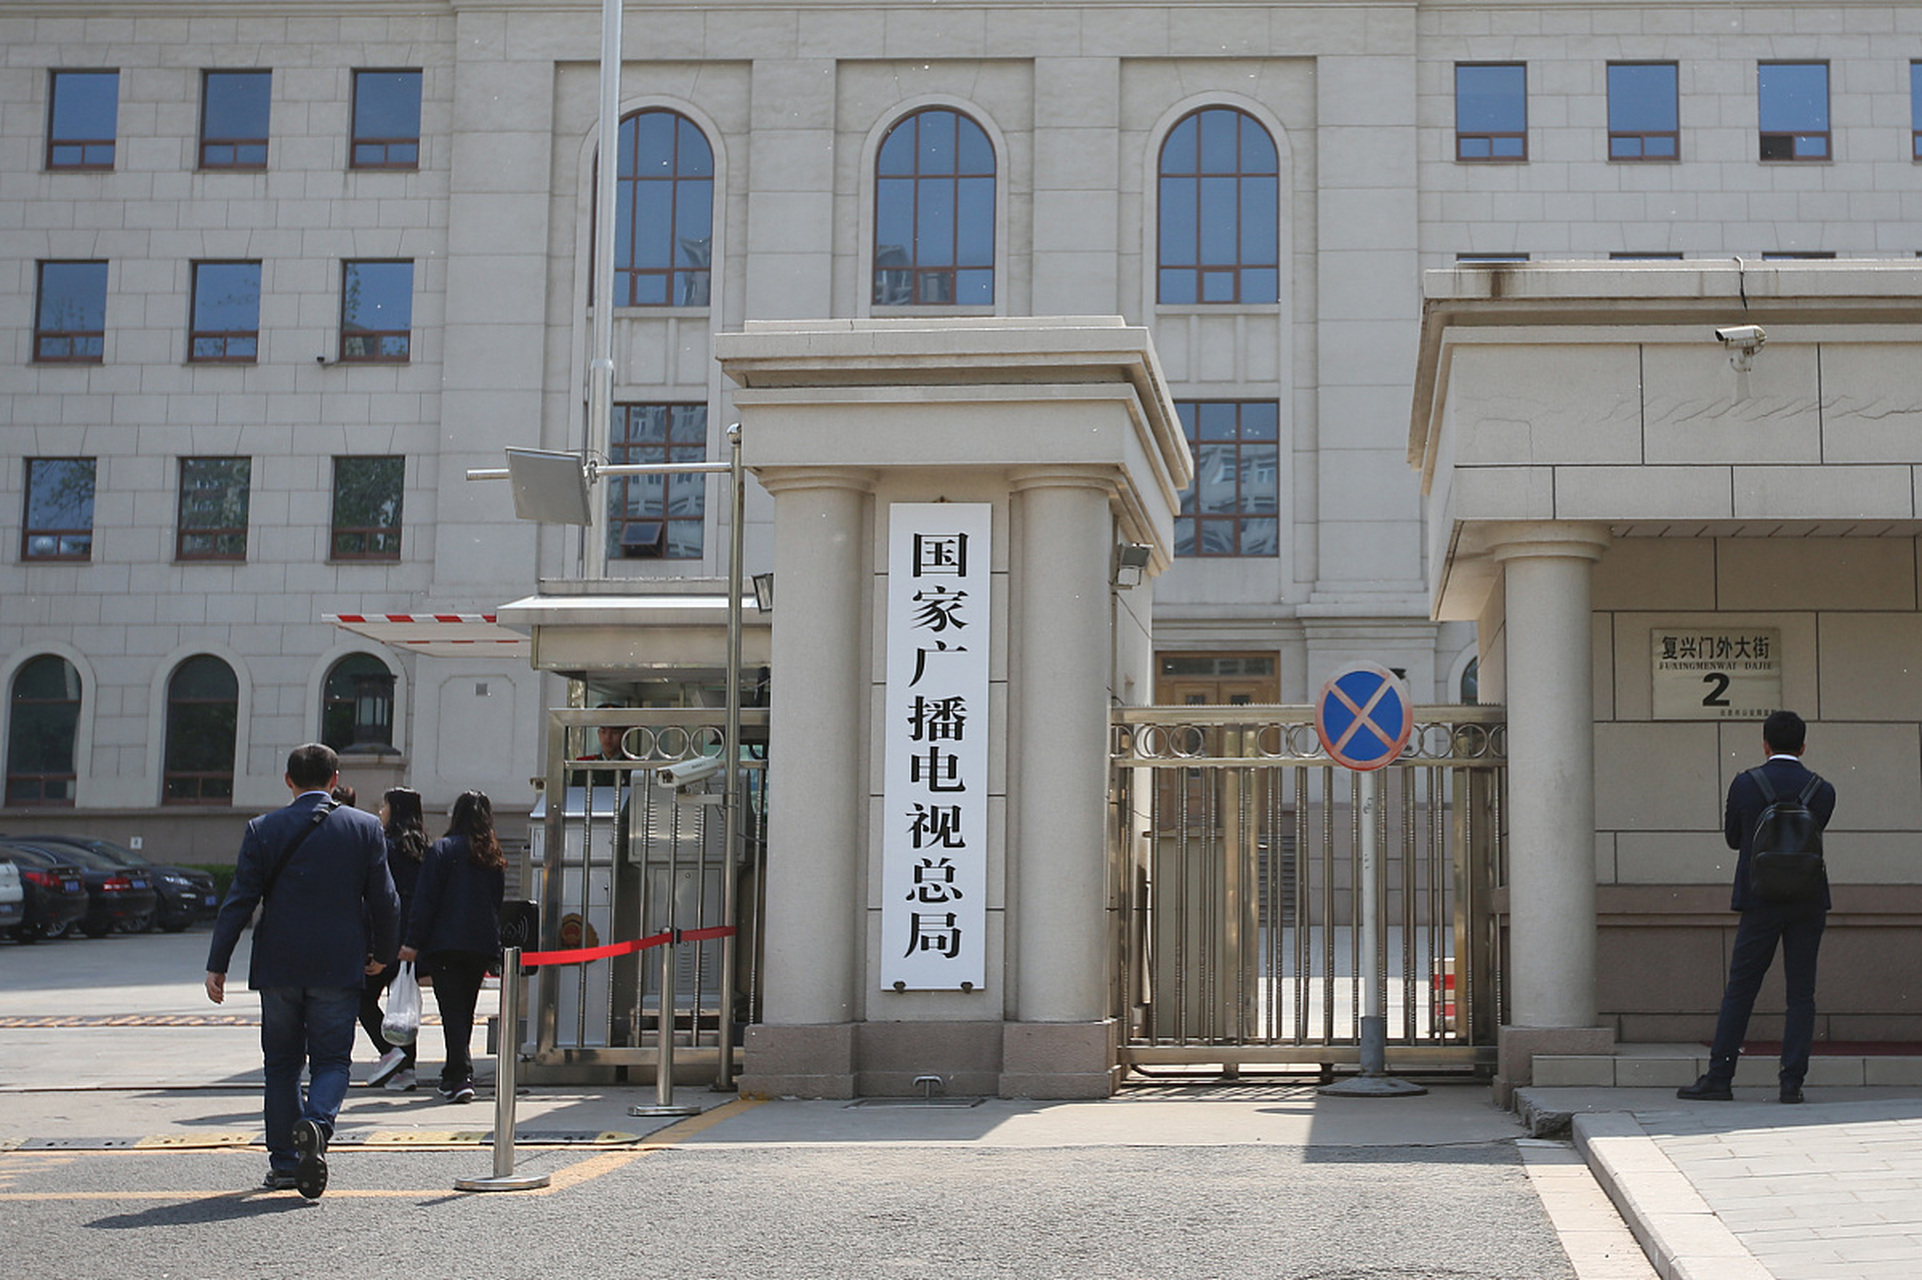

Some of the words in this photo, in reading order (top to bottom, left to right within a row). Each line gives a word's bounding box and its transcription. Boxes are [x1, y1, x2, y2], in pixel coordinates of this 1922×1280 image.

[1662, 635, 1770, 660] 复兴门外大街
[1659, 661, 1737, 670] FUXINGMENWAI
[1745, 661, 1772, 670] DAJIE
[1702, 672, 1730, 707] 2
[904, 532, 969, 960] 国家广播电视总局
